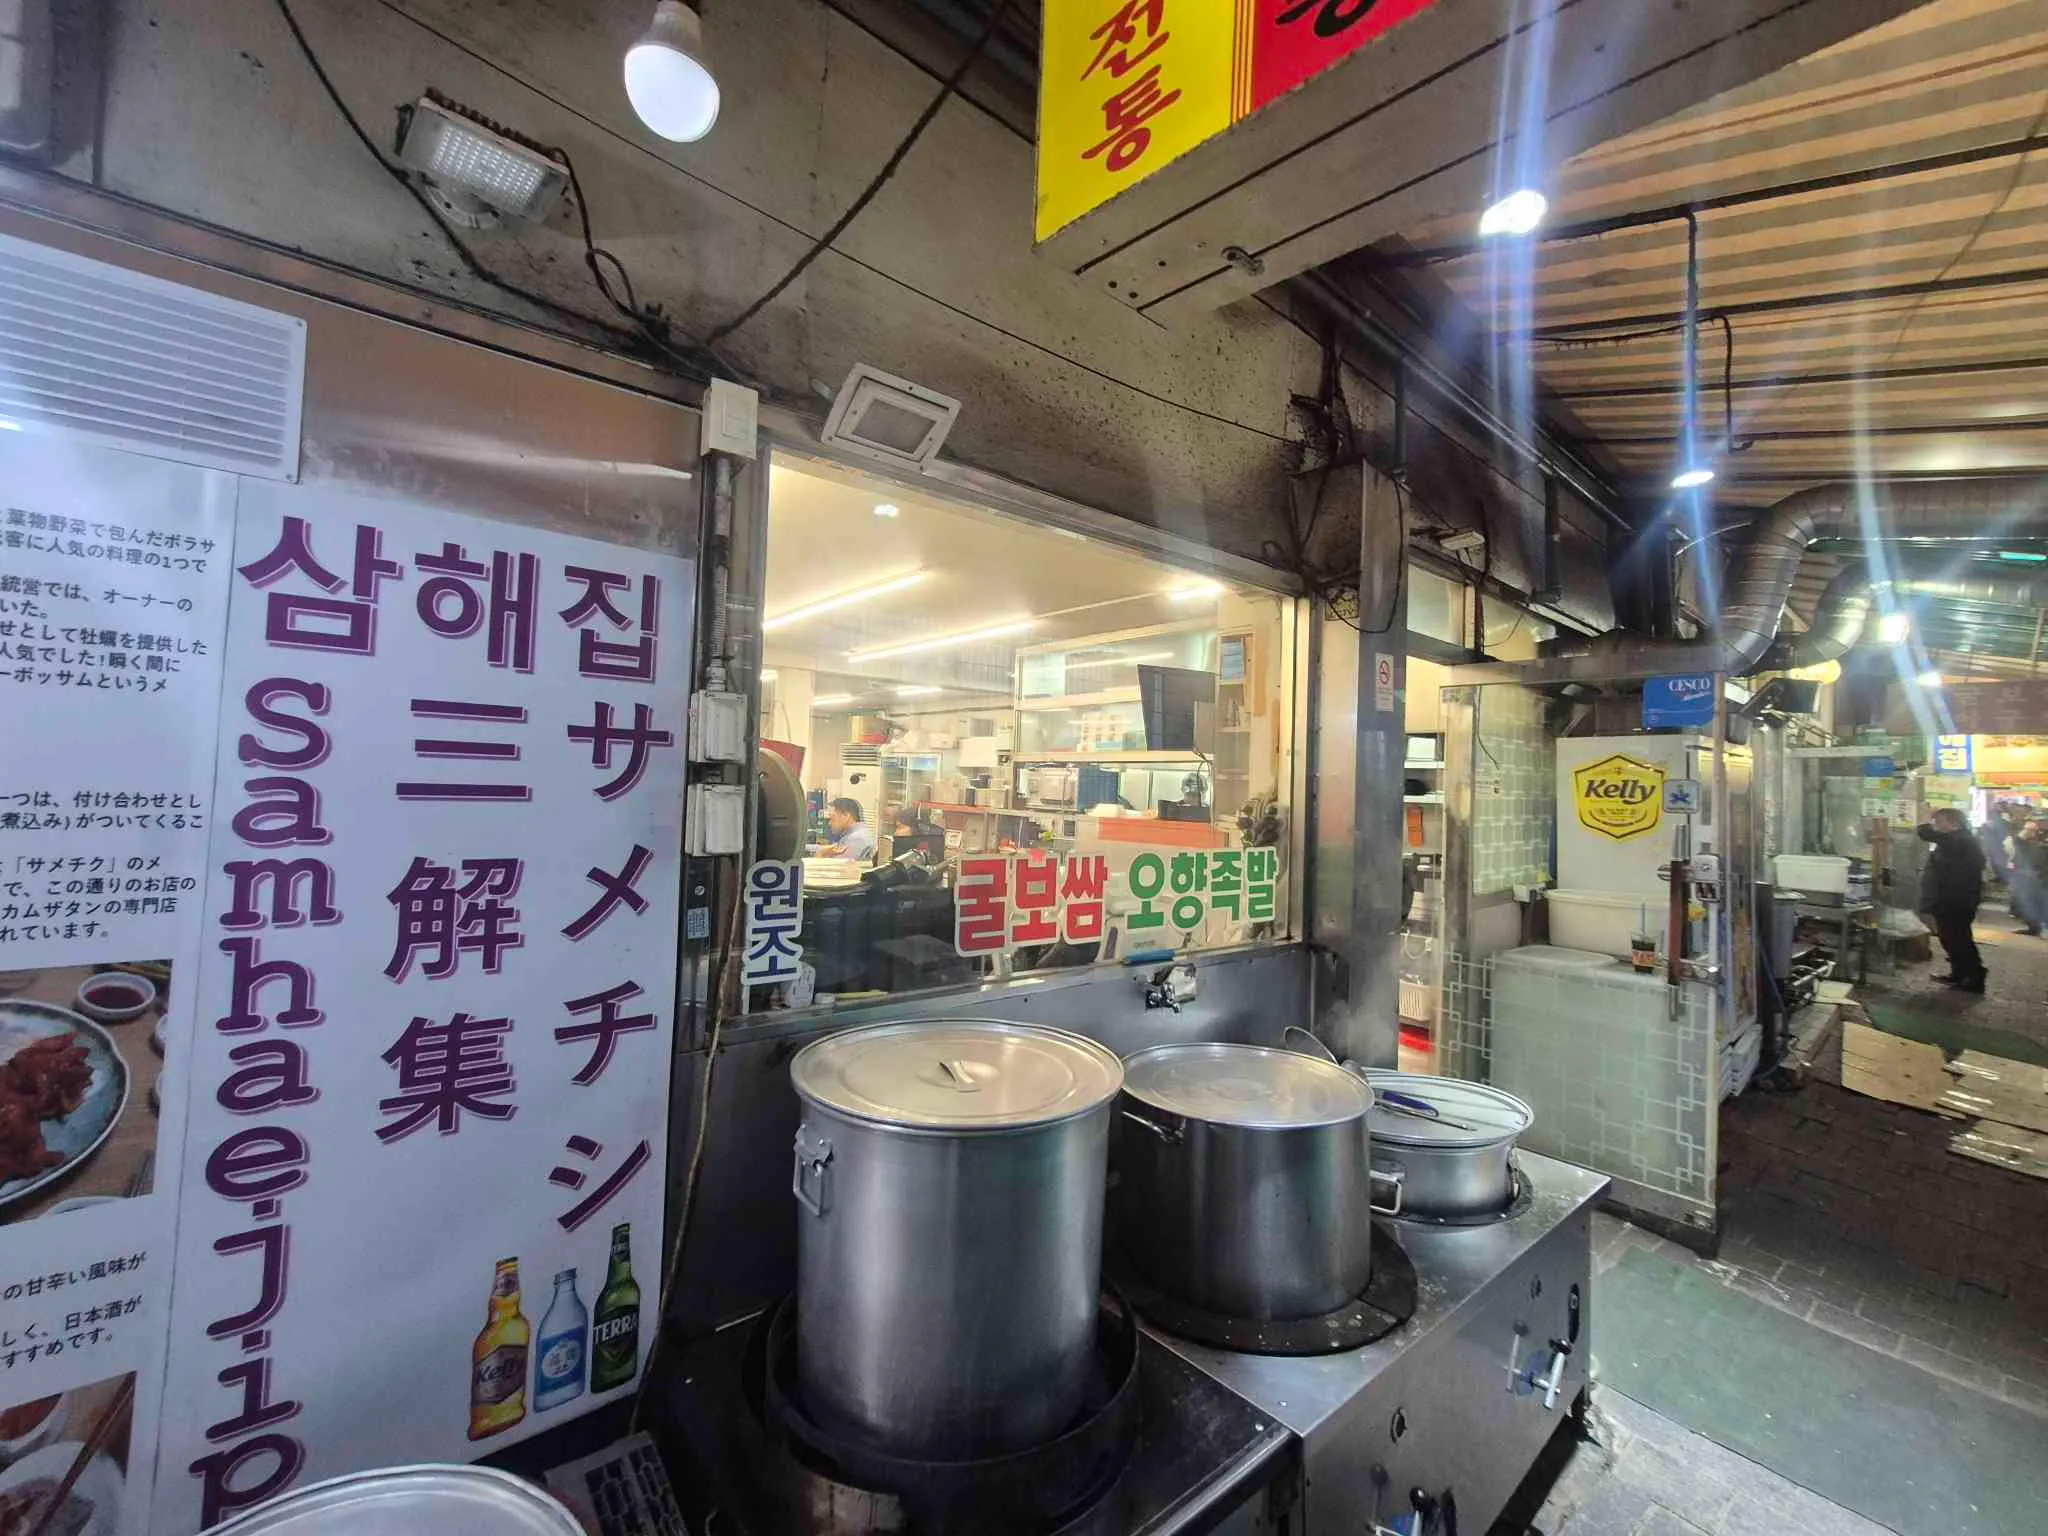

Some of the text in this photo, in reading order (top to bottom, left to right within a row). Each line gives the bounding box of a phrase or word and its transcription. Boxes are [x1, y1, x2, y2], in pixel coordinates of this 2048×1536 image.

[1080, 0, 1182, 172] 전통
[0, 508, 216, 553] 葉物野菜で包んだボラサ
[0, 529, 207, 573] 客に人気の料理の1つで
[237, 515, 660, 682] 삼해집
[1584, 779, 1656, 805] Kelly
[0, 856, 161, 873] 「サメチク」のメ
[1, 897, 177, 919] カムザタンの専門店
[958, 851, 1277, 951] 굴보쌈 오향족발
[375, 698, 532, 1143] 三解集
[548, 701, 674, 1232] サメチシ
[747, 864, 799, 979] 원조
